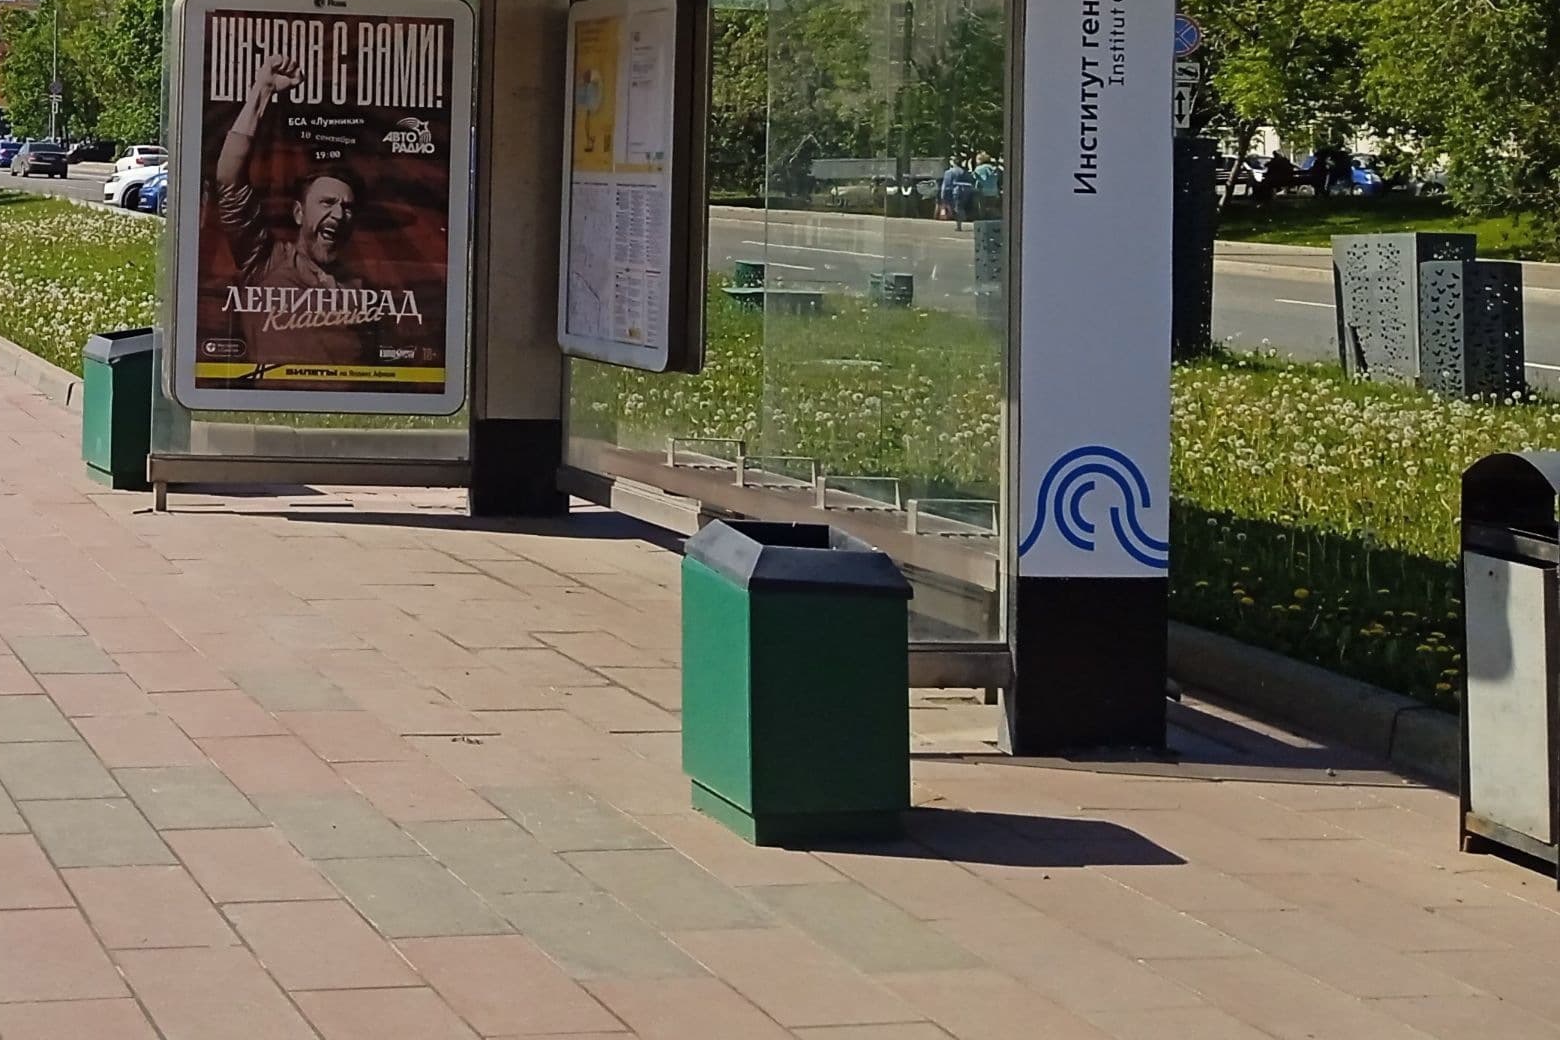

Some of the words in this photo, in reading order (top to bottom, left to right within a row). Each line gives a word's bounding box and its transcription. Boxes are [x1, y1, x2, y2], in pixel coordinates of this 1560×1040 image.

[1109, 8, 1126, 86] Institut
[332, 21, 348, 105] С
[357, 22, 444, 109] ВАМИ!
[288, 117, 308, 126] БСА
[1073, 56, 1104, 194] Институт
[382, 132, 417, 142] АВТО
[392, 143, 435, 154] РАДИО
[316, 151, 341, 159] 19:00
[222, 286, 422, 326] ЛЕНИНГРАД
